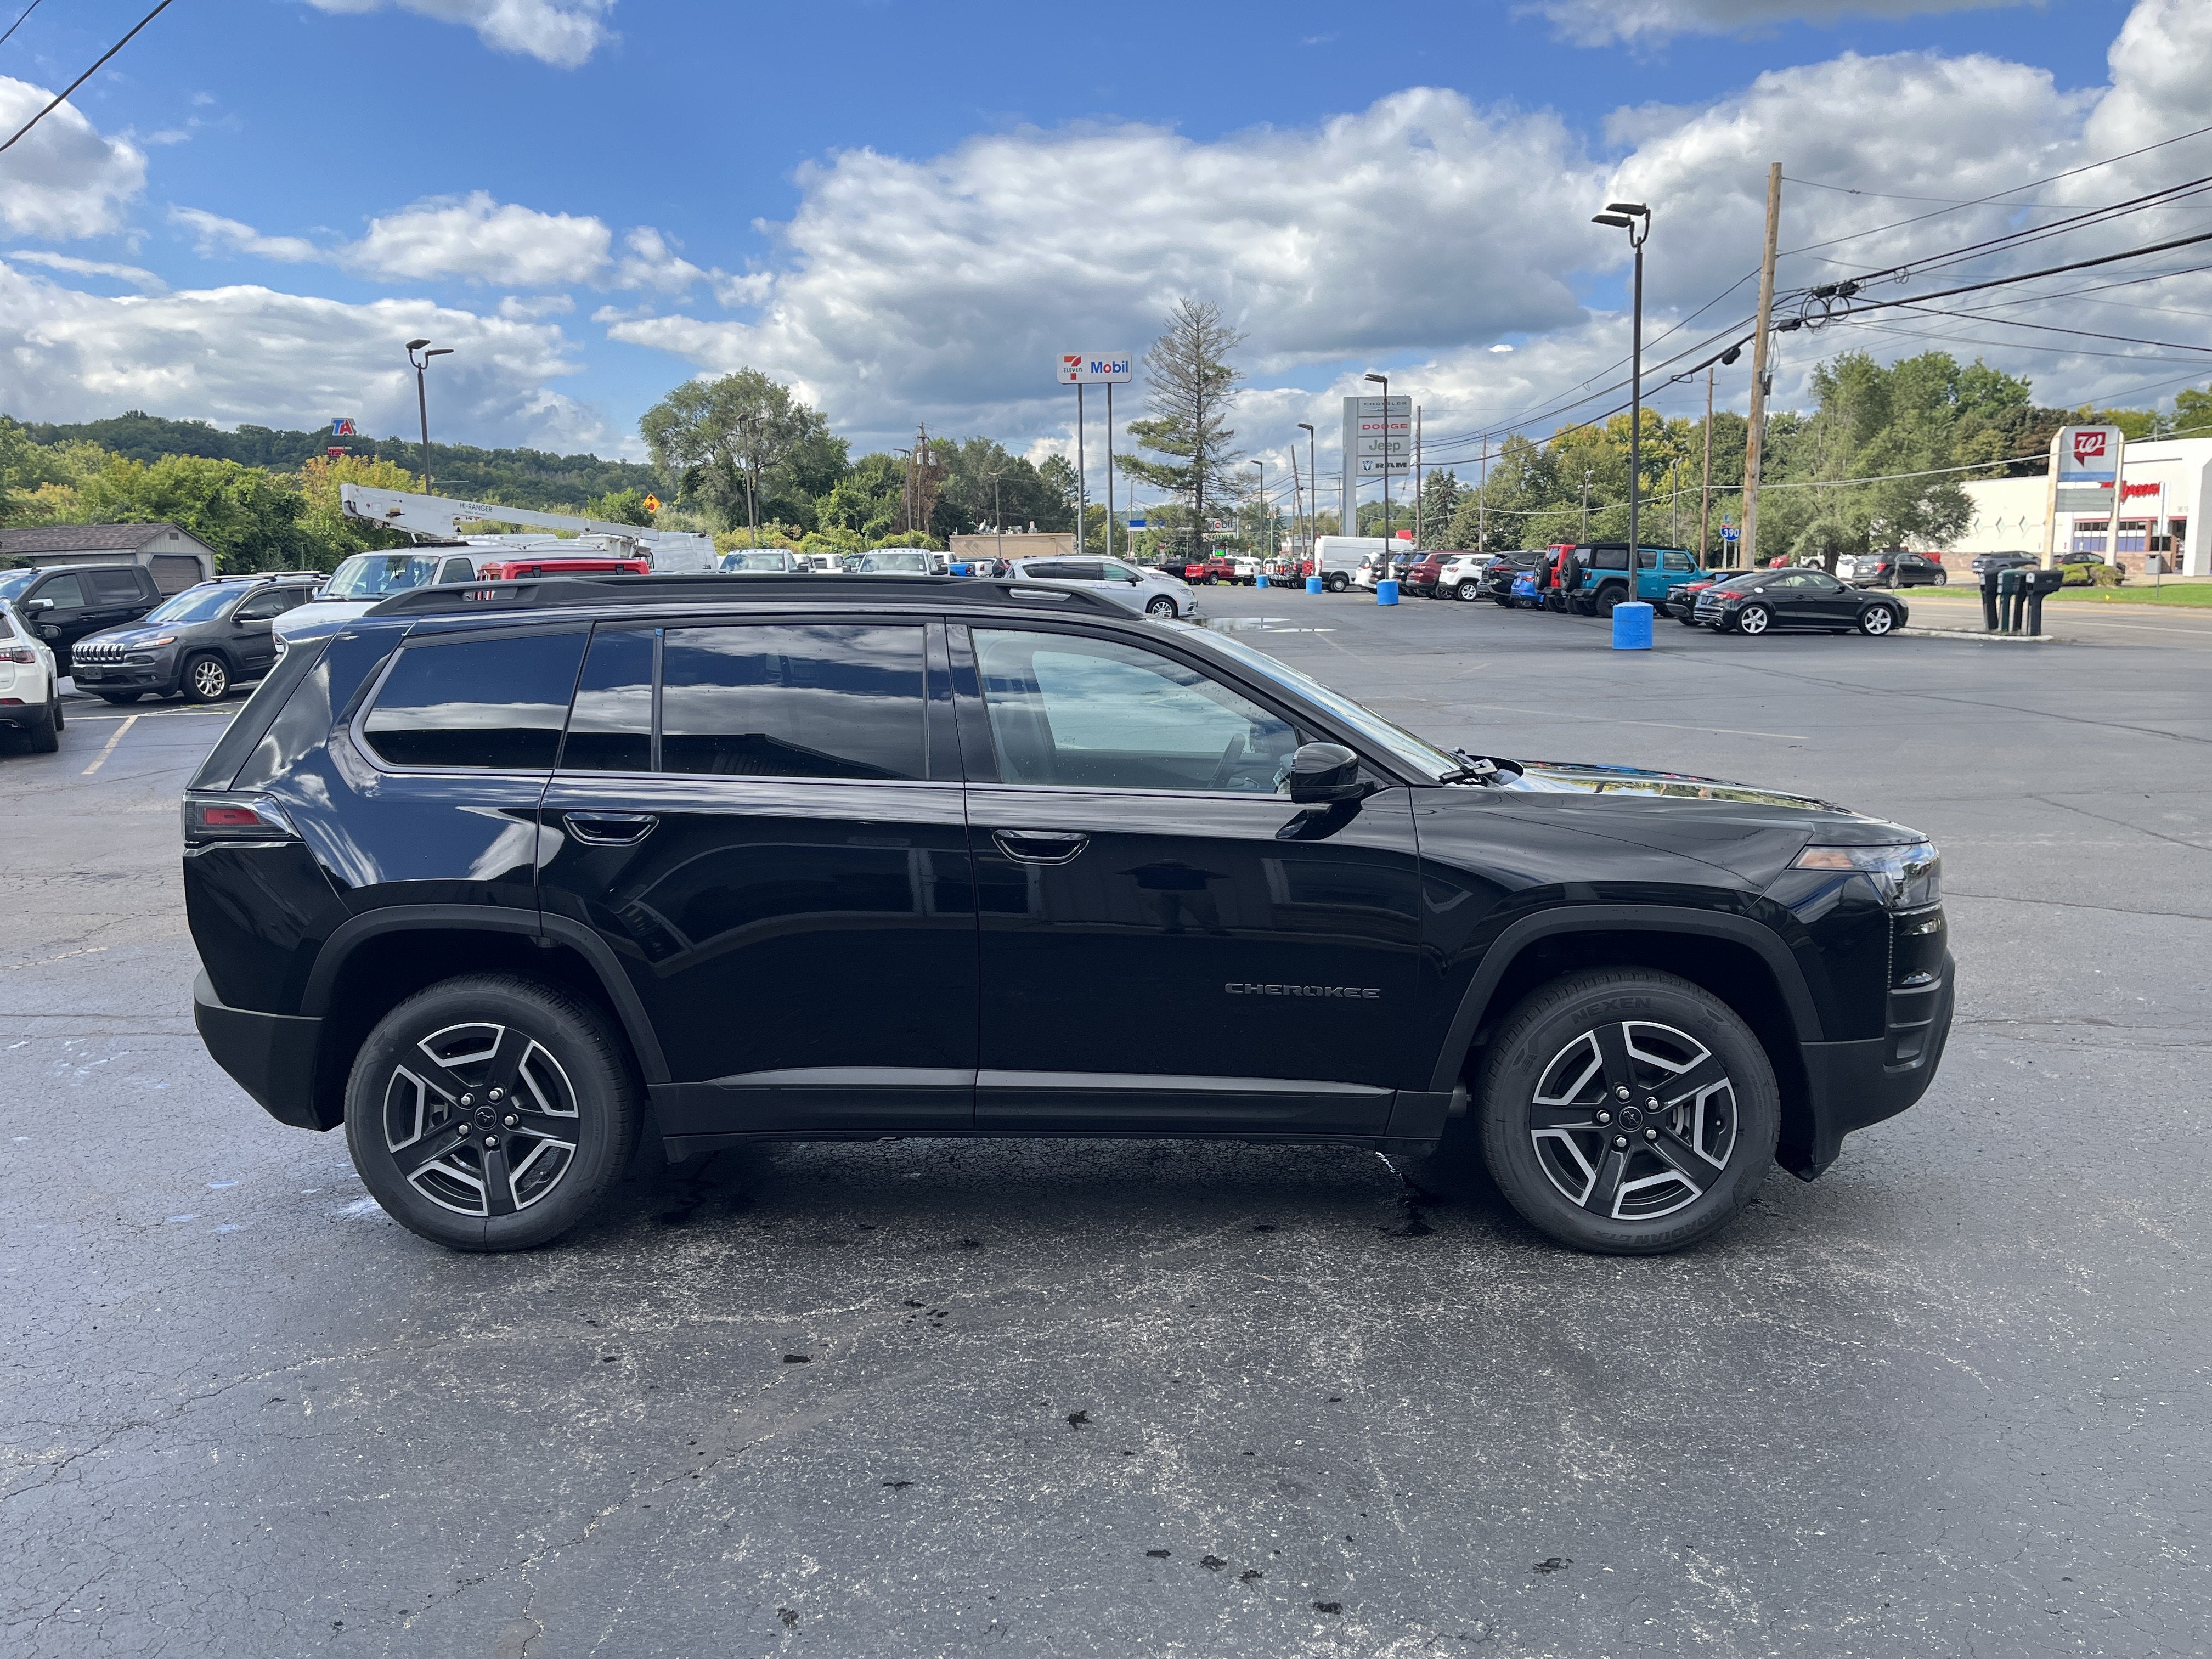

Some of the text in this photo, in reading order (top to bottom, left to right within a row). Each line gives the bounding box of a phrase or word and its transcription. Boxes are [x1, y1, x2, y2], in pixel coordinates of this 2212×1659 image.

[1064, 356, 1082, 380] 7
[1090, 360, 1128, 374] Mobil
[333, 419, 353, 435] TA
[1369, 439, 1401, 452] Jeep
[2076, 434, 2103, 453] W
[460, 502, 493, 512] HI-RANGER
[1723, 528, 1740, 538] 390
[1225, 983, 1380, 999] CHEROKEE
[1571, 997, 1651, 1024] NEXEN
[1633, 1204, 1722, 1246] ROADIAN
